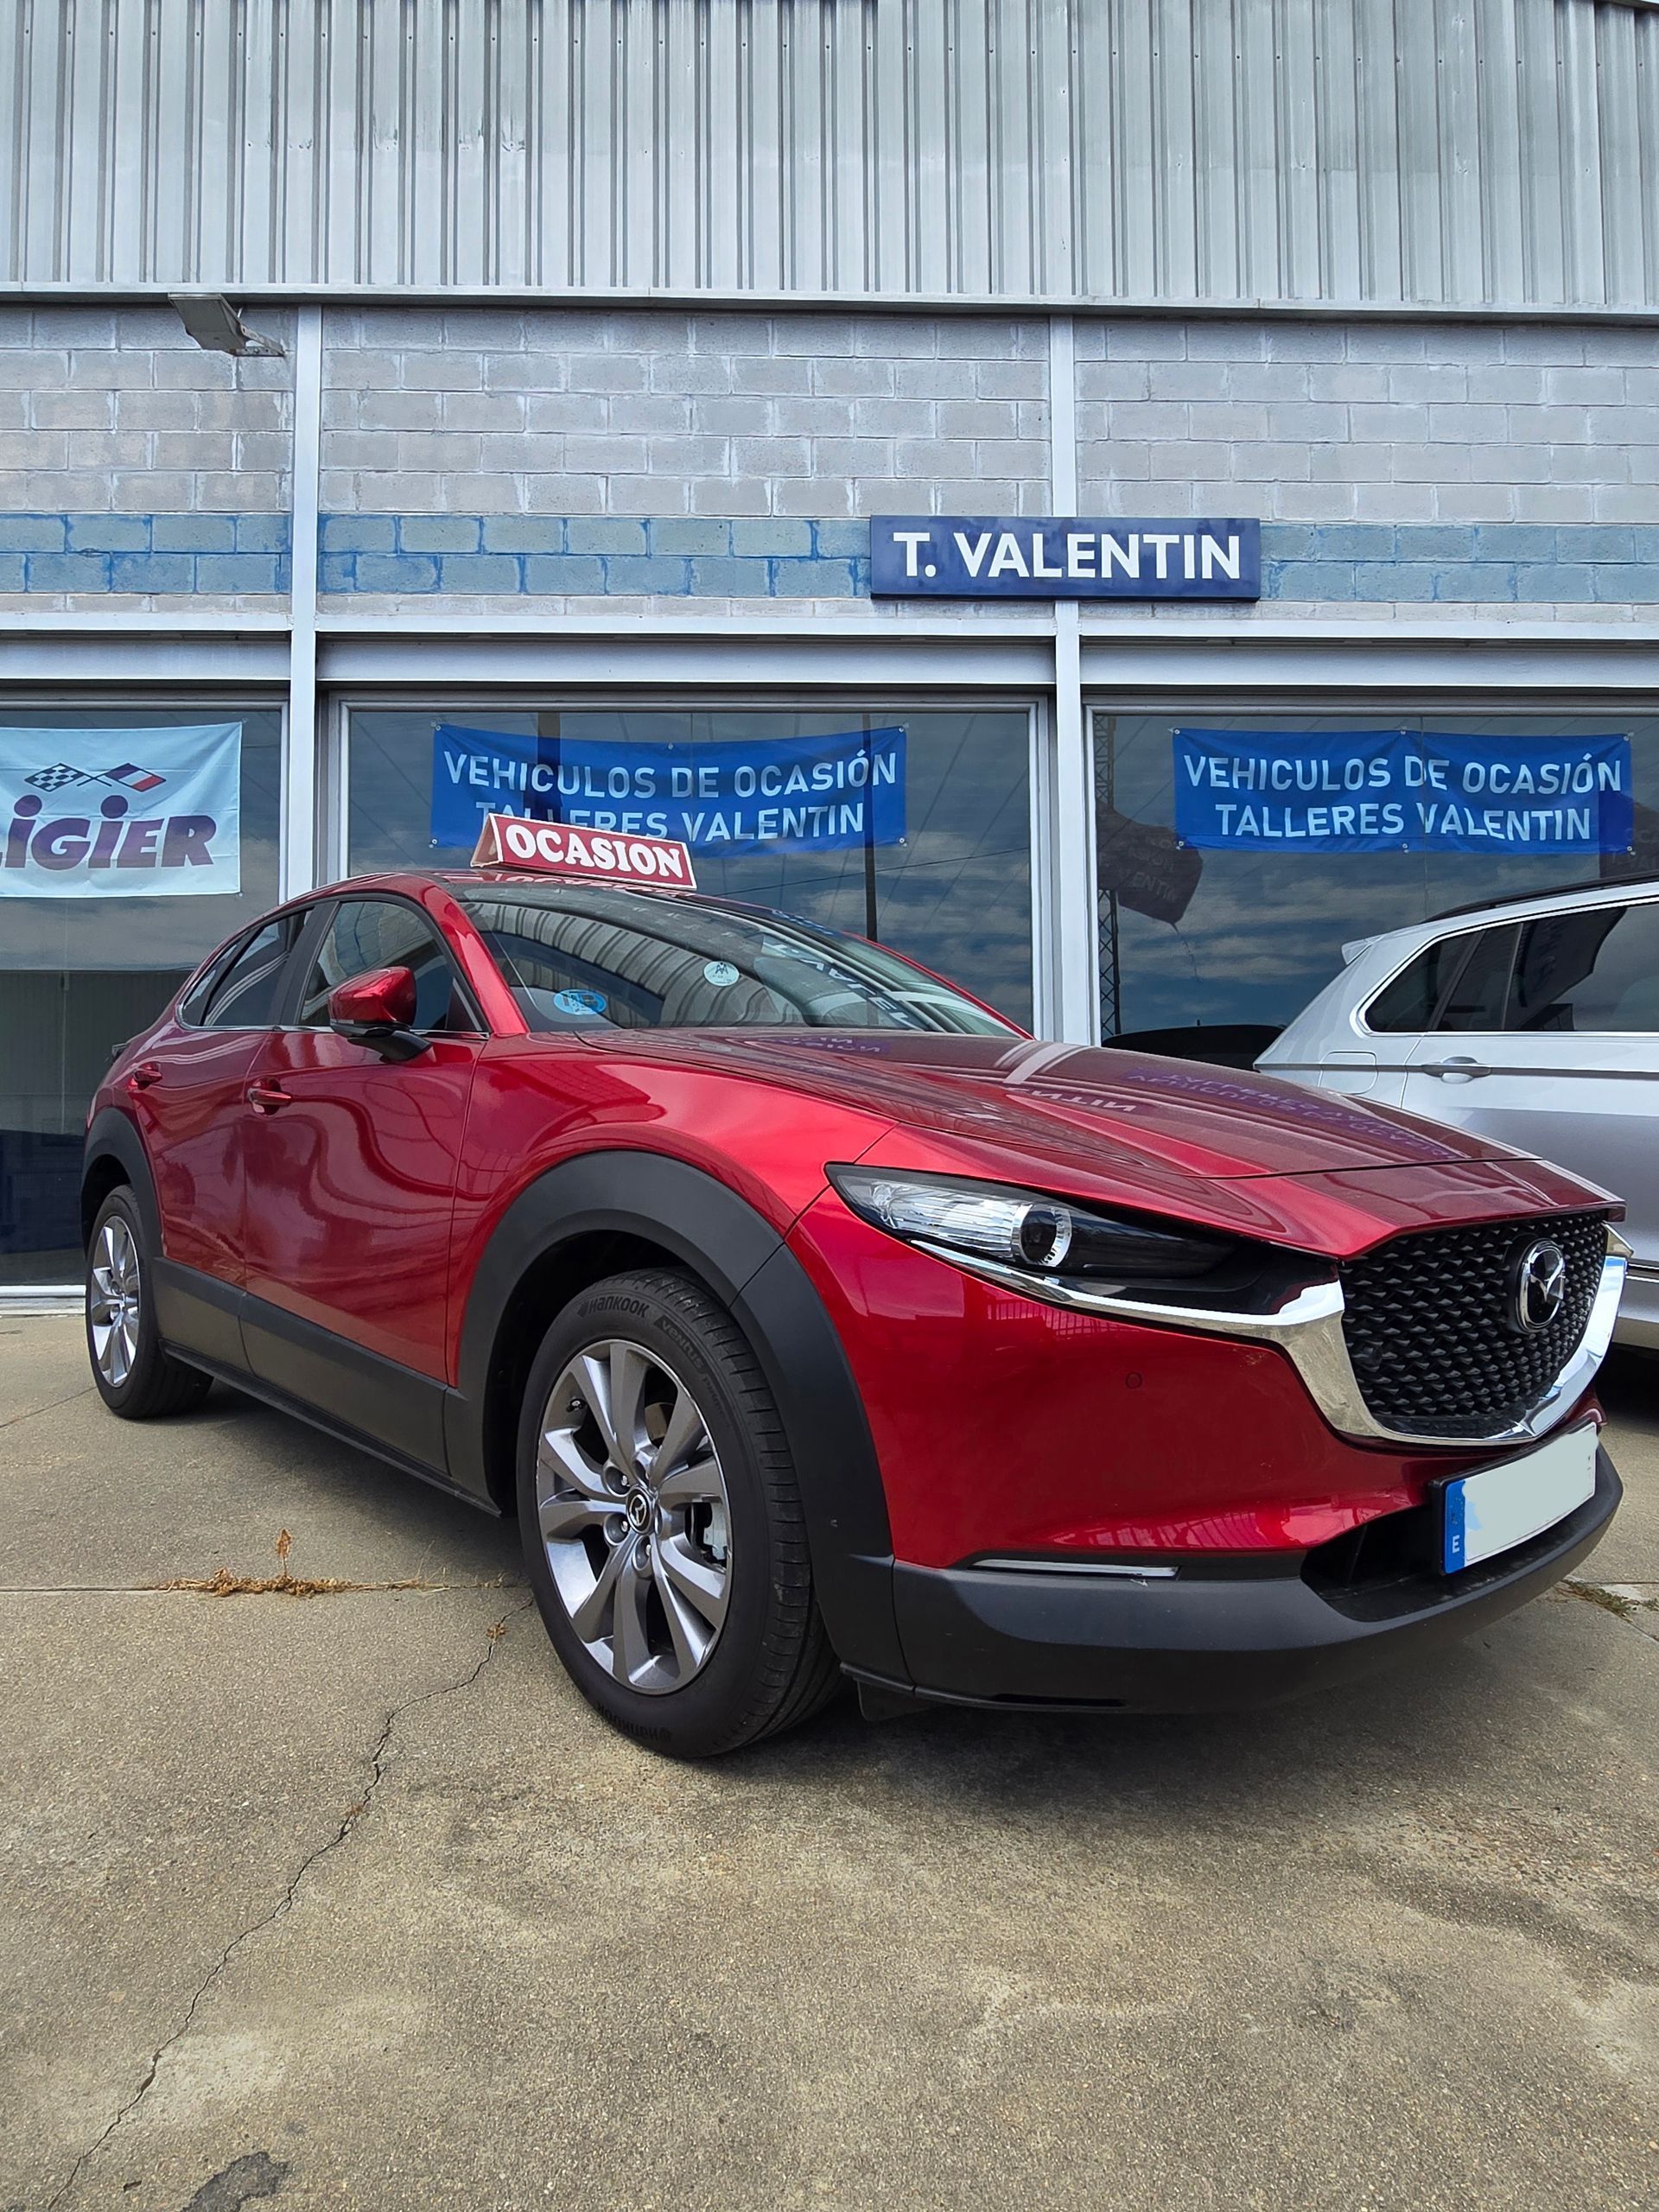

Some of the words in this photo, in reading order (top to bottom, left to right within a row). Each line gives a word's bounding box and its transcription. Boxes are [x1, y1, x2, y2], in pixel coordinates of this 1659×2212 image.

[893, 532, 936, 576] T.
[953, 532, 1240, 579] VALENTIN
[443, 751, 657, 799] VEHICULOS
[671, 766, 719, 798] DE
[734, 749, 896, 797] OCASIÓN
[1184, 754, 1391, 791] VEHICULOS
[1404, 754, 1450, 791] DE
[1462, 753, 1621, 794] OCASIÓN
[0, 794, 216, 870] iGiER
[682, 803, 863, 842] VALENTIN
[1215, 803, 1405, 838] TALLERES
[1415, 802, 1590, 841] VALENTIN
[505, 824, 683, 879] OCASION
[1452, 1535, 1460, 1554] E
